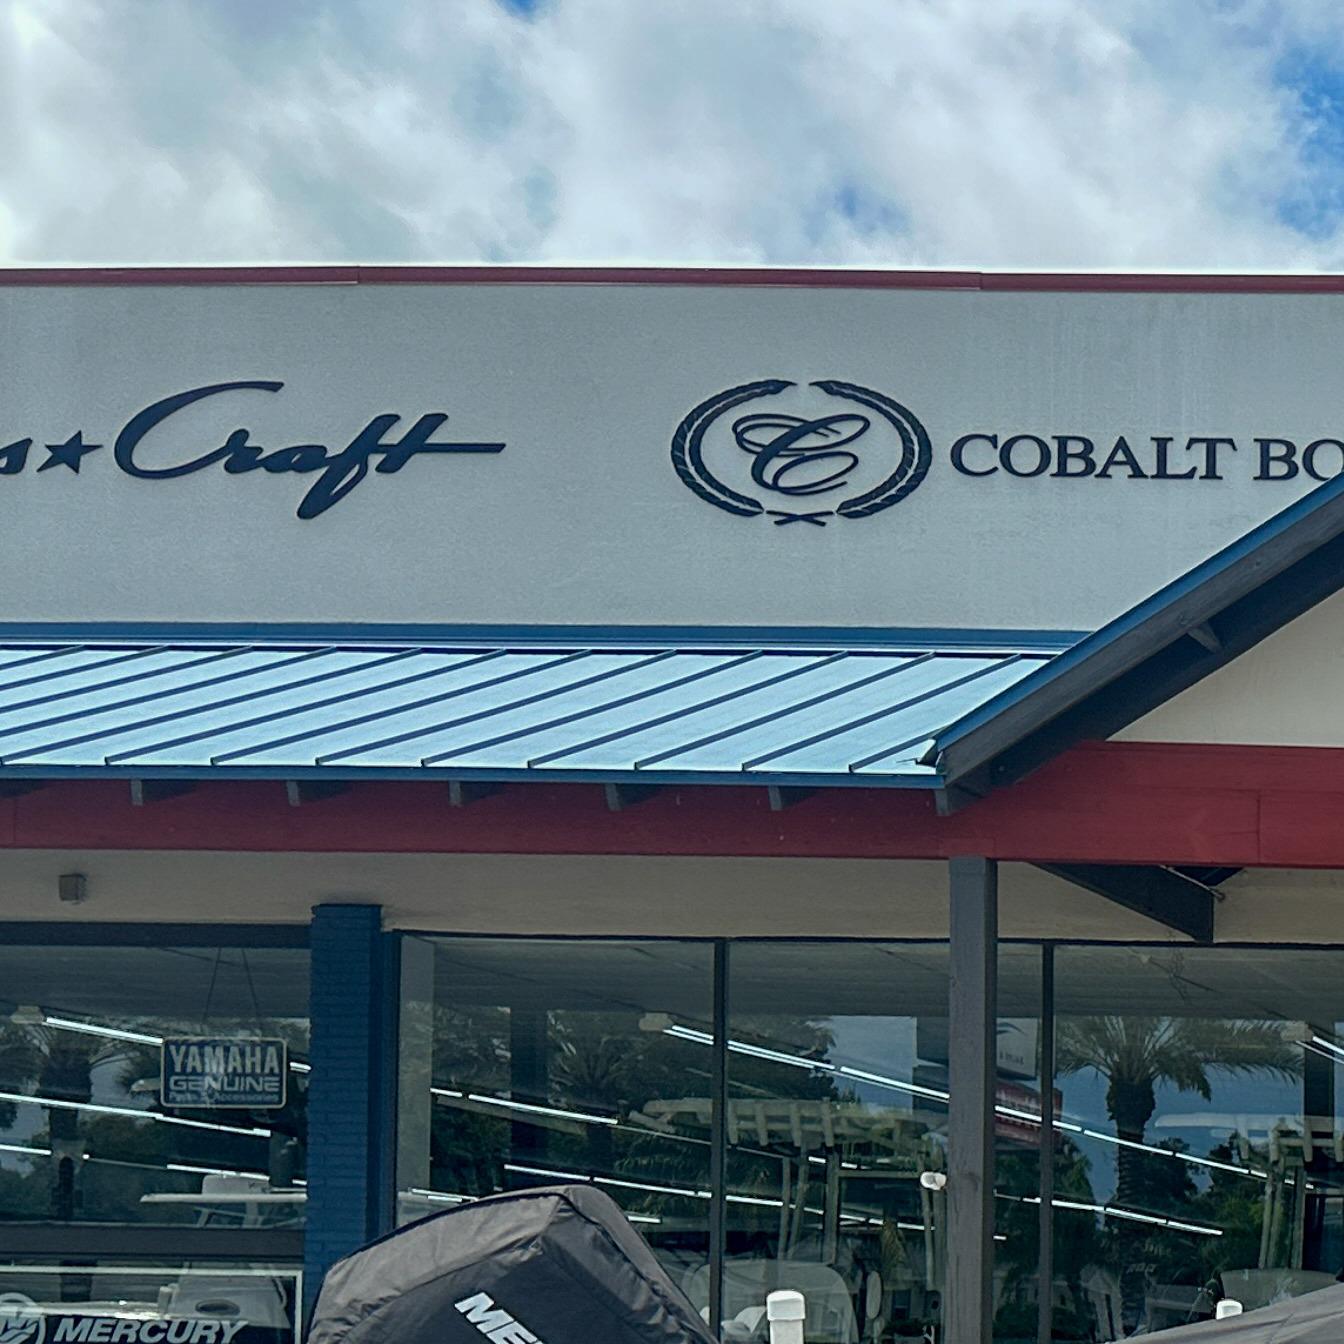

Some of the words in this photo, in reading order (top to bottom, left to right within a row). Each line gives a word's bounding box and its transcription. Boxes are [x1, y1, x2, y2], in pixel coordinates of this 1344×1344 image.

[114, 381, 506, 519] Craft
[950, 434, 1238, 480] COBALT
[169, 1045, 280, 1074] YAMAHA
[169, 1075, 280, 1093] GENUINE
[53, 1317, 248, 1344] MERCURY
